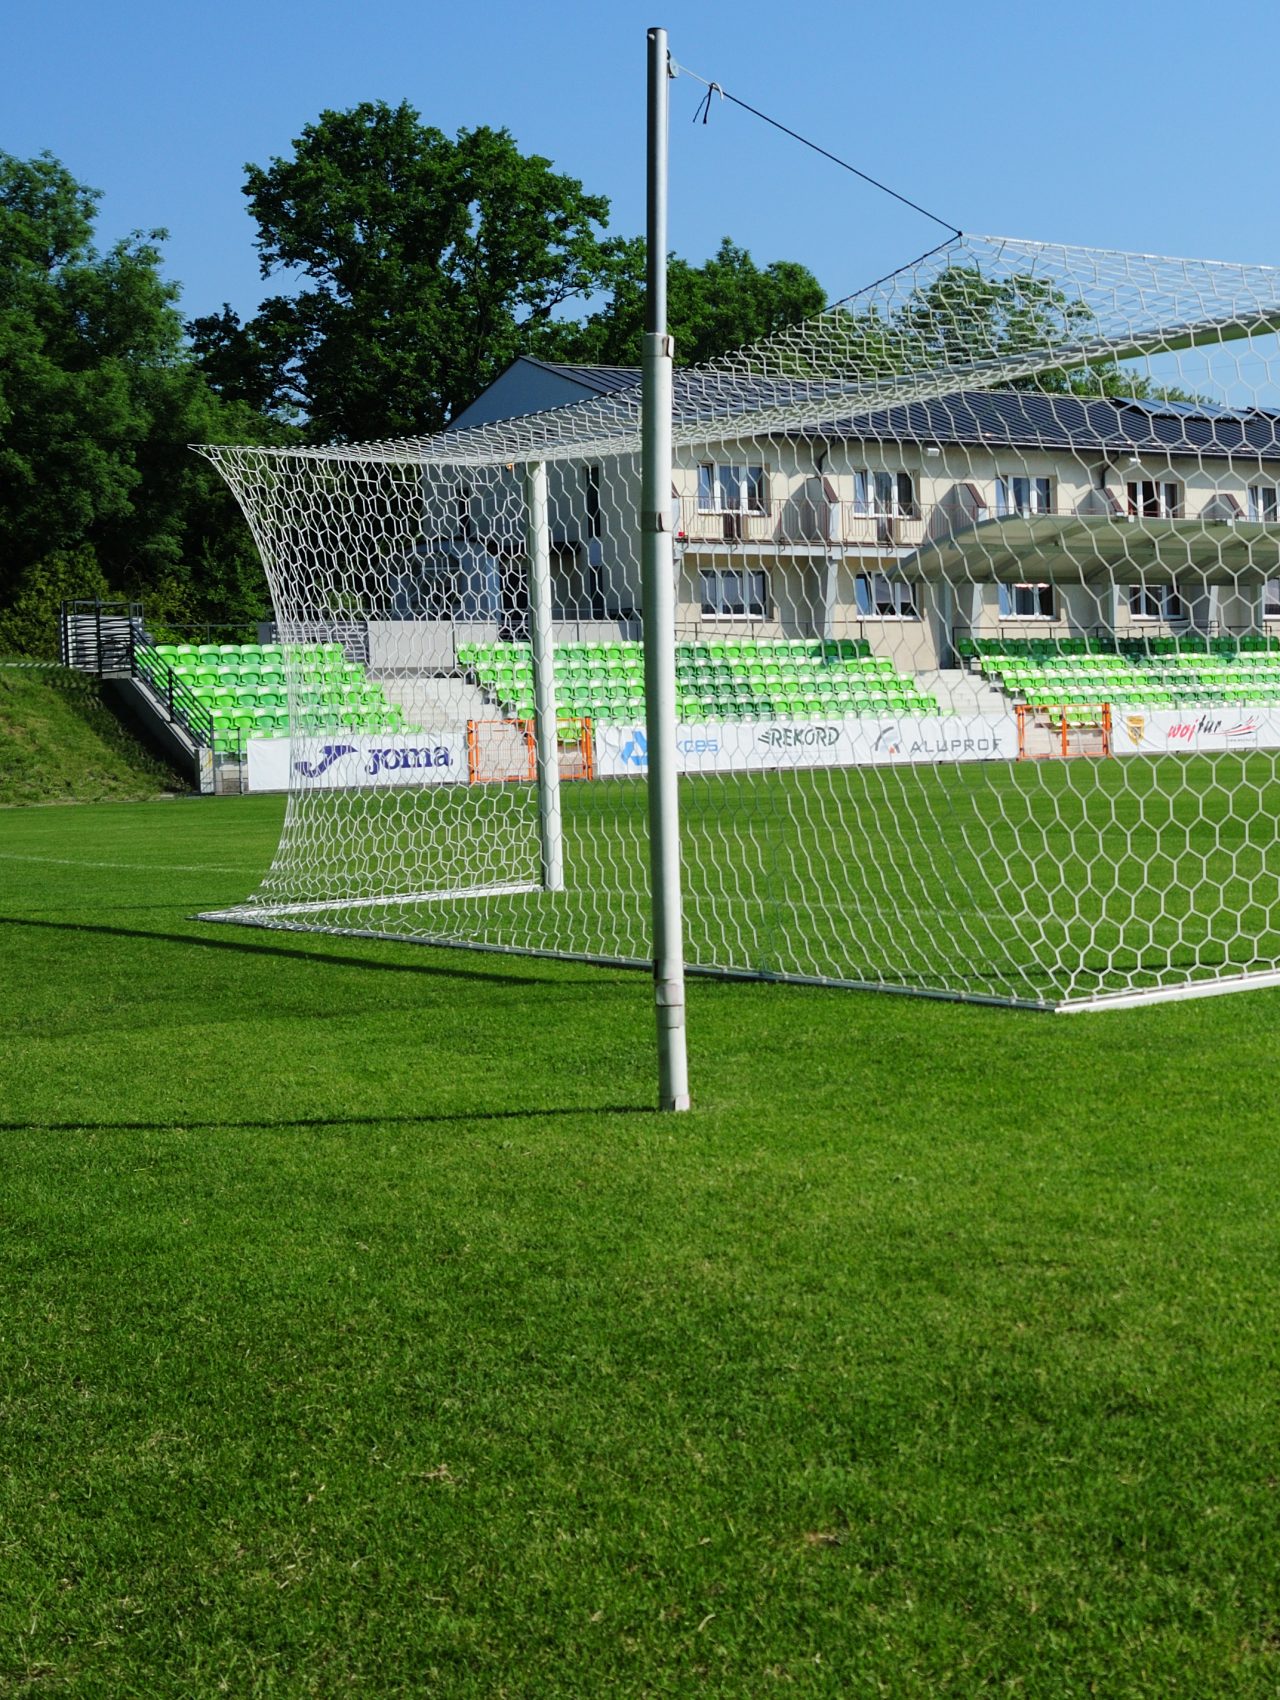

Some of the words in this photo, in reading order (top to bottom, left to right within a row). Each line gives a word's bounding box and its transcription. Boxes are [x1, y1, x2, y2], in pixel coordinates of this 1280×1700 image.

[769, 727, 840, 748] REKORD
[1167, 714, 1222, 743] wojtur
[910, 738, 1002, 753] ALUPROF
[364, 746, 454, 775] joma
